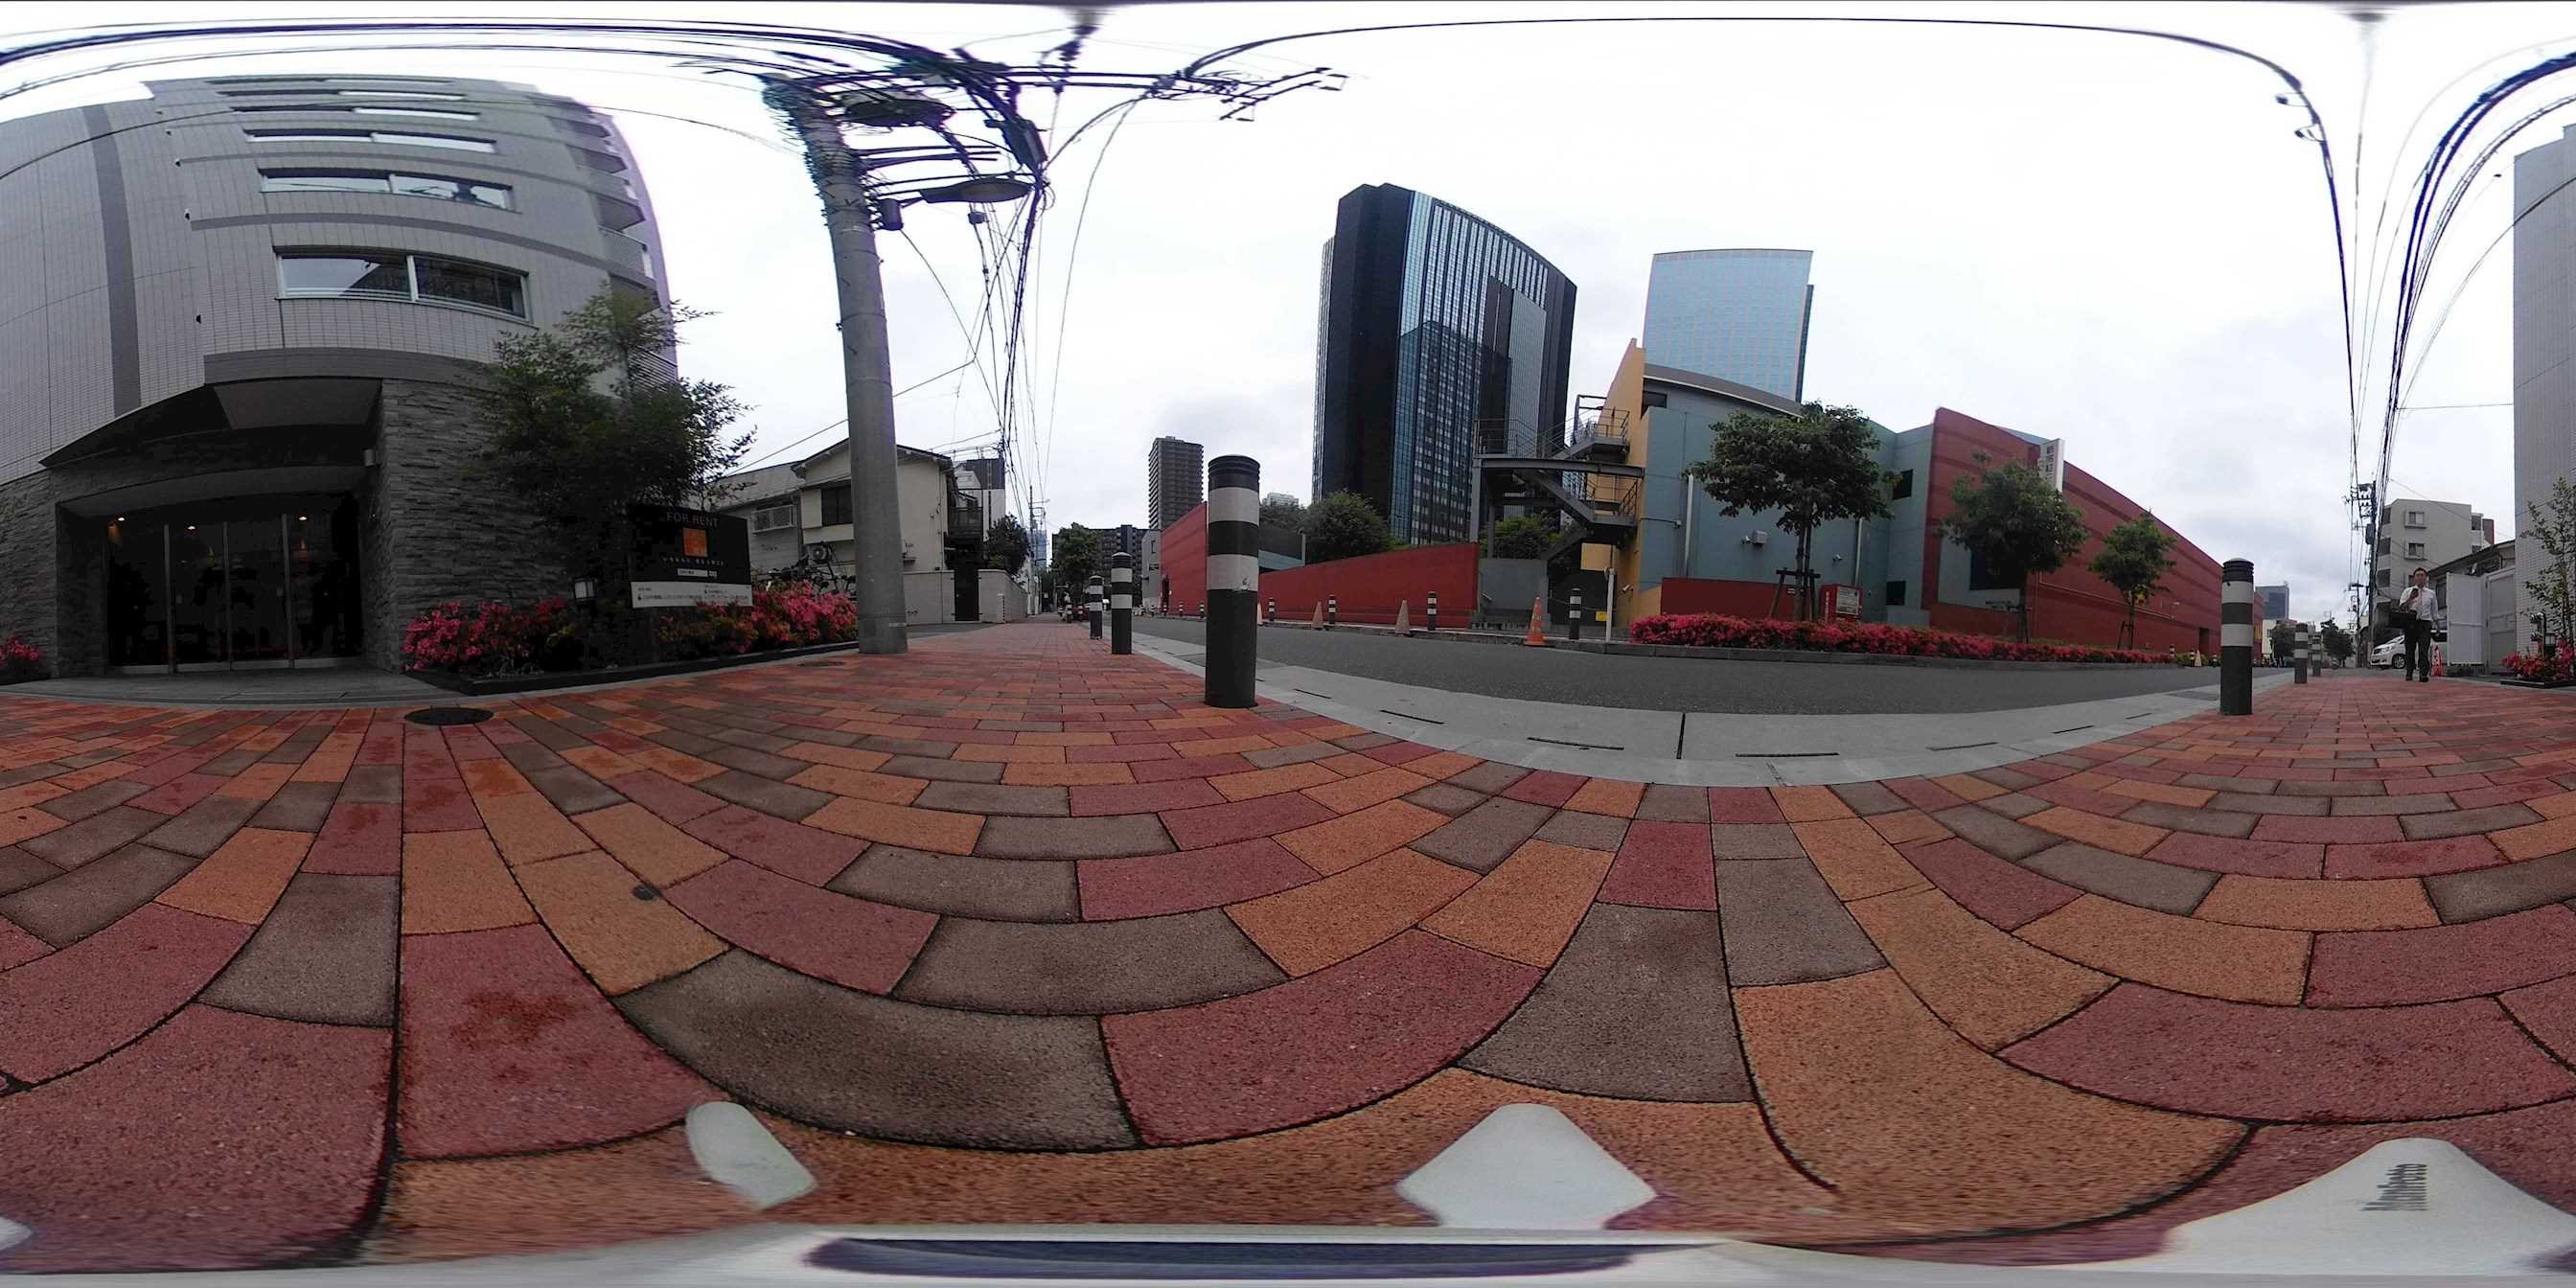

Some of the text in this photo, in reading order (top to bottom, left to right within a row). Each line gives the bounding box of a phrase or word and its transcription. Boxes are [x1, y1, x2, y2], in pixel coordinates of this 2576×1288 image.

[666, 512, 719, 528] FOR RENT
[2360, 1163, 2427, 1211] Manfrotto
